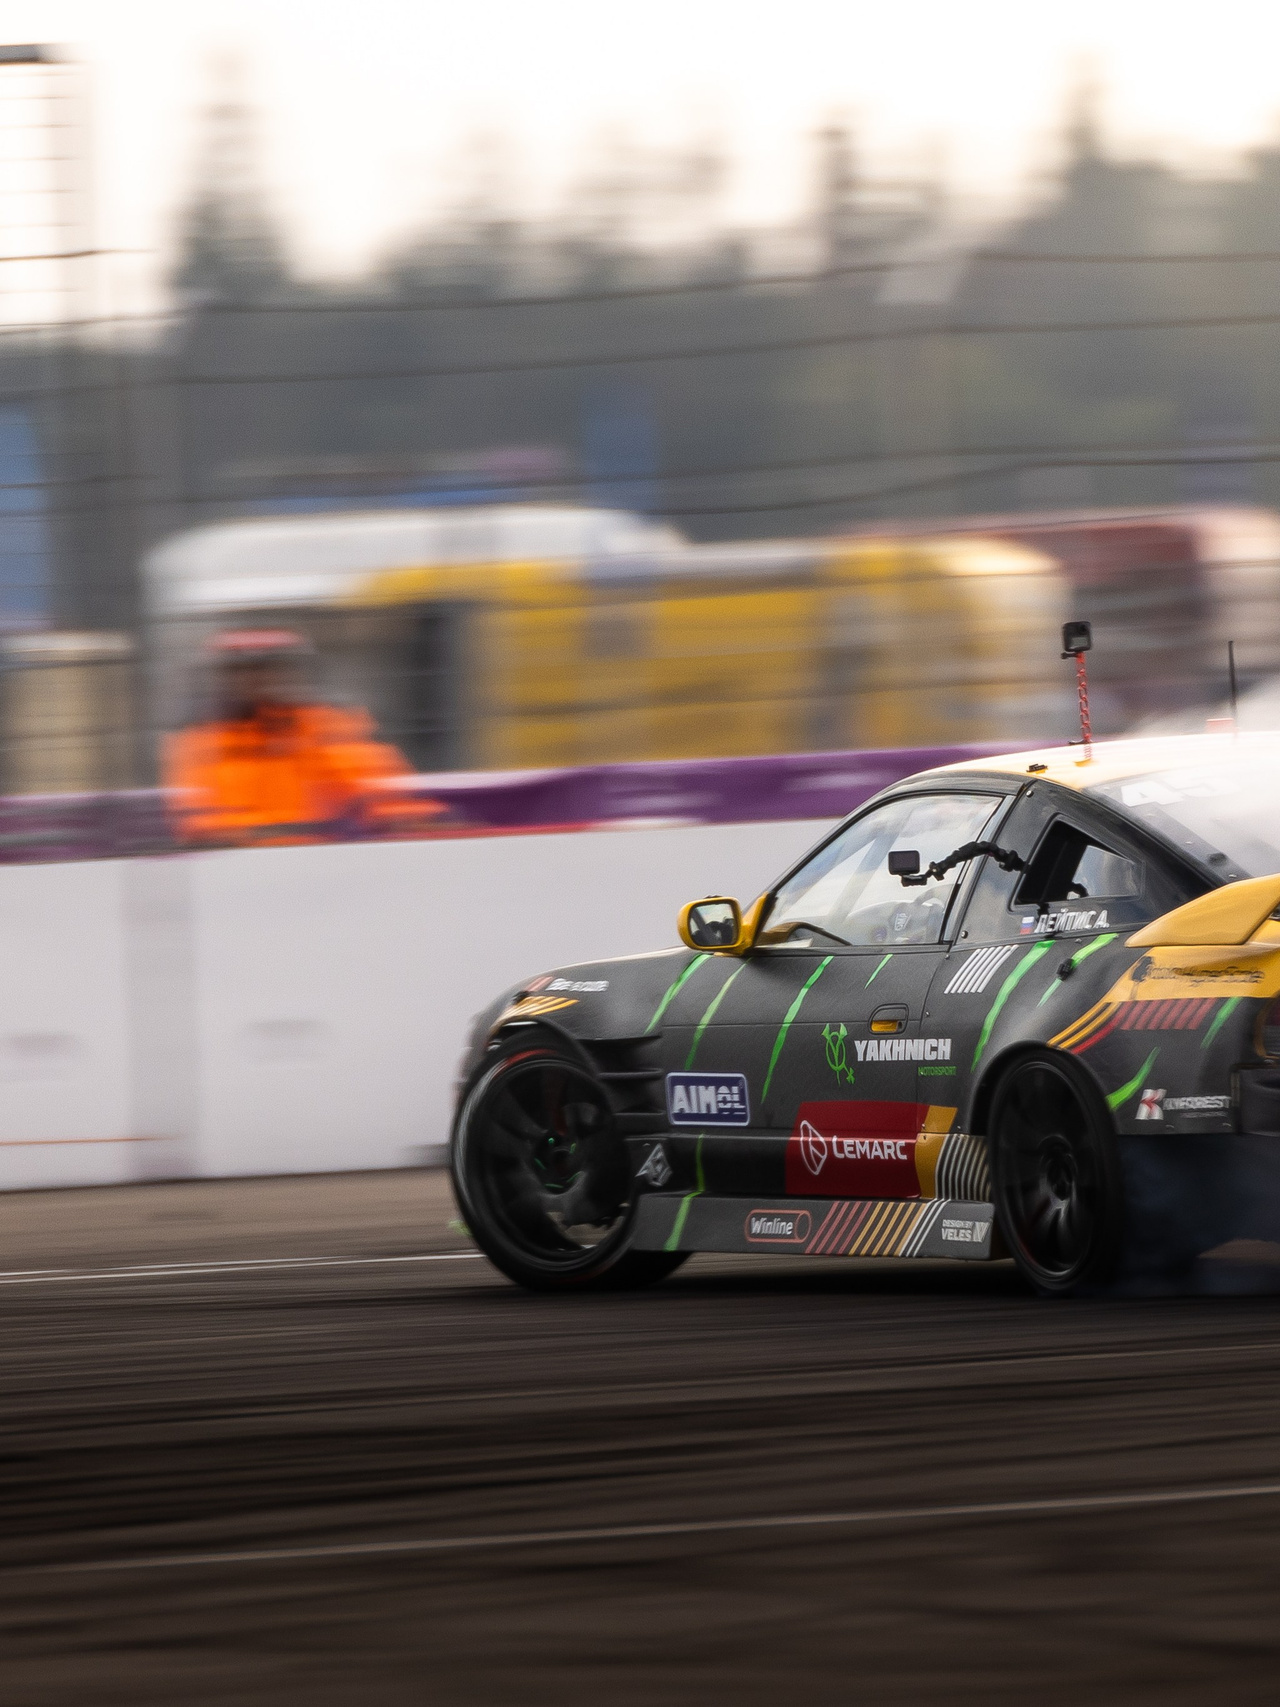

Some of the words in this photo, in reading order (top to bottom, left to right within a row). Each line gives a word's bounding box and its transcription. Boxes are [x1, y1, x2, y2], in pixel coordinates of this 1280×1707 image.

[854, 1038, 952, 1062] YAKHNICH
[917, 1066, 957, 1076] MOTORSPORT
[672, 1084, 747, 1115] AIMOL
[831, 1134, 908, 1160] LEMARC
[750, 1216, 794, 1235] Winline
[941, 1227, 973, 1242] VELES
